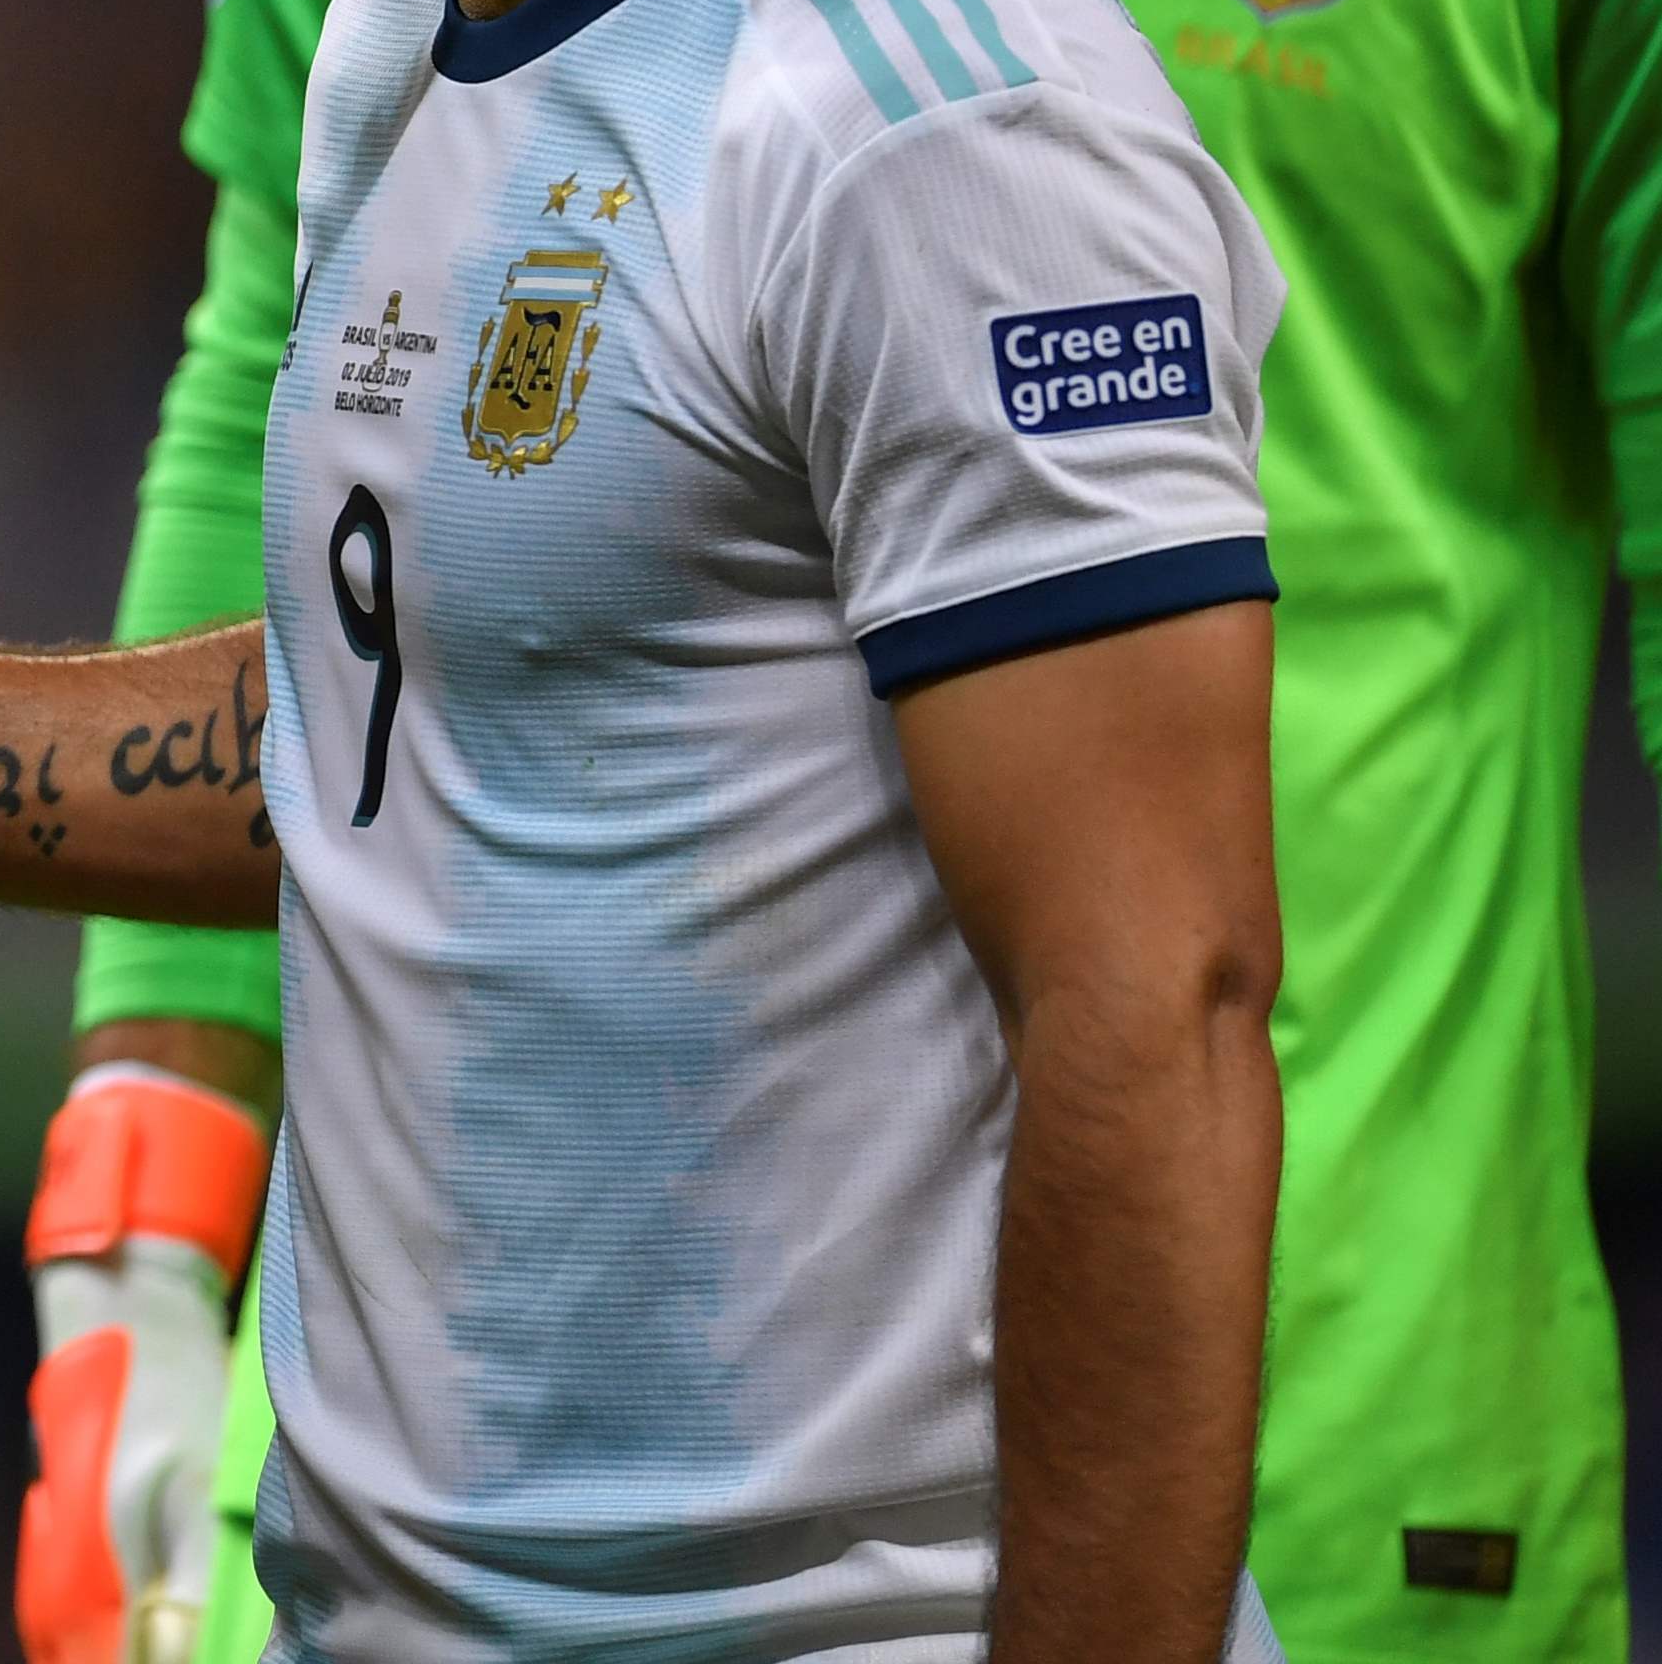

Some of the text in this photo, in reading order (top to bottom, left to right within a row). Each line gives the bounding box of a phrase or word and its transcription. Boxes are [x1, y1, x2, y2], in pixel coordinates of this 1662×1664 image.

[341, 324, 377, 347] BRASIL
[394, 331, 438, 355] ARGENTINA
[1004, 317, 1192, 369] Cree en
[341, 362, 412, 388] 02 JULIO 2019
[334, 390, 404, 417] BELO HORIZONTE
[328, 483, 403, 828] 9
